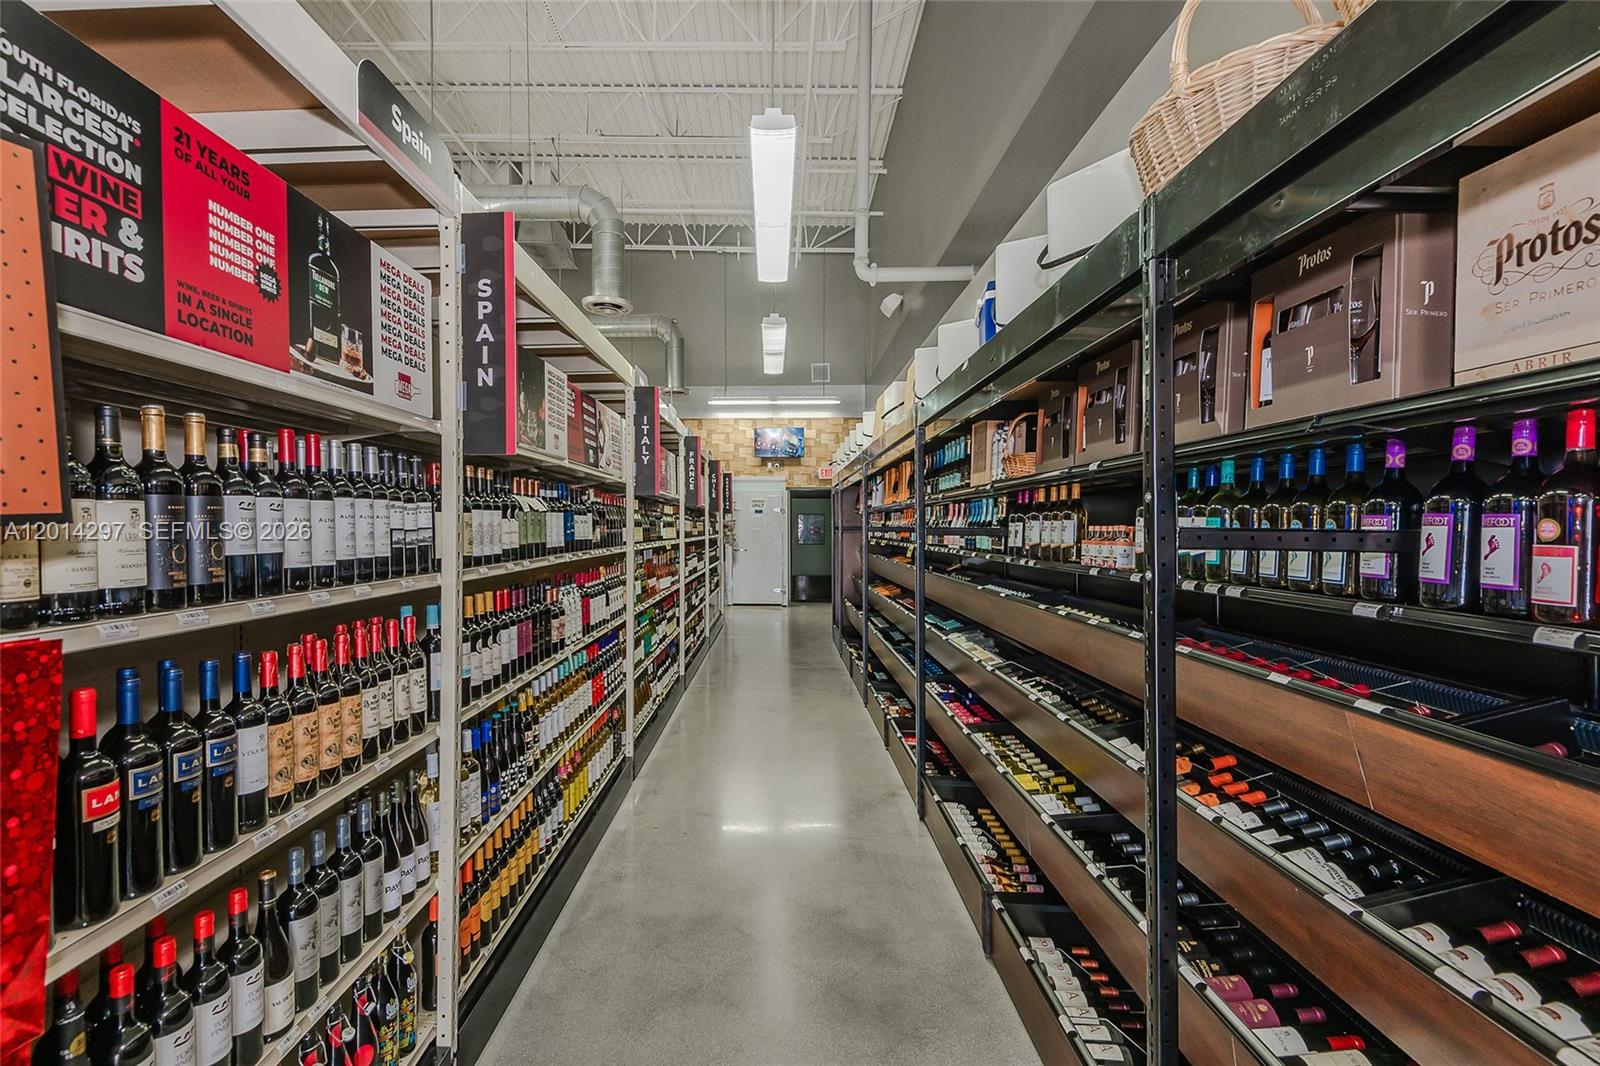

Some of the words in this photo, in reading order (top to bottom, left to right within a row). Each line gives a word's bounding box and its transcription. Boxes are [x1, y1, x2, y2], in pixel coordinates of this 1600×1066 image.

[0, 27, 54, 82] OUTH
[56, 72, 142, 135] FLORIDA'S
[391, 104, 432, 165] Spain
[174, 126, 191, 150] 21
[196, 140, 250, 187] YEARS
[174, 147, 192, 164] OF
[195, 161, 217, 181] ALL
[221, 175, 251, 201] YOUR
[52, 151, 138, 212] WINE
[53, 185, 108, 237] ER
[118, 217, 144, 251] &
[208, 199, 254, 234] NUMBER
[255, 226, 275, 245] ONE
[208, 213, 254, 246] NUMBER
[255, 239, 275, 257] ONE
[51, 220, 145, 283] IRITS
[208, 227, 254, 258] NUMBER
[208, 241, 254, 271] NUMBER
[1298, 246, 1332, 277] Protos
[1487, 212, 1600, 287] Protos
[208, 255, 254, 284] NUMBER
[379, 258, 402, 280] MEGA
[403, 275, 425, 294] DEALS
[379, 270, 402, 292] MEGA
[403, 286, 425, 305] DEALS
[177, 291, 192, 308] IN
[195, 300, 206, 313] A
[209, 304, 253, 330] SINGLE
[380, 283, 402, 303] MEGA
[403, 298, 425, 316] DEALS
[380, 295, 402, 316] MEGA
[403, 310, 425, 328] DEALS
[177, 309, 253, 347] LOCATION
[380, 308, 402, 328] MEGA
[403, 321, 425, 339] DEALS
[380, 321, 403, 340] MEGA
[404, 333, 426, 350] DEALS
[475, 278, 495, 387] SPAIN
[380, 333, 403, 353] MEGA
[404, 345, 426, 361] DEALS
[380, 346, 403, 365] MEGA
[404, 356, 426, 373] DEALS
[1512, 351, 1574, 375] ABRIR
[641, 415, 650, 465] ITALY
